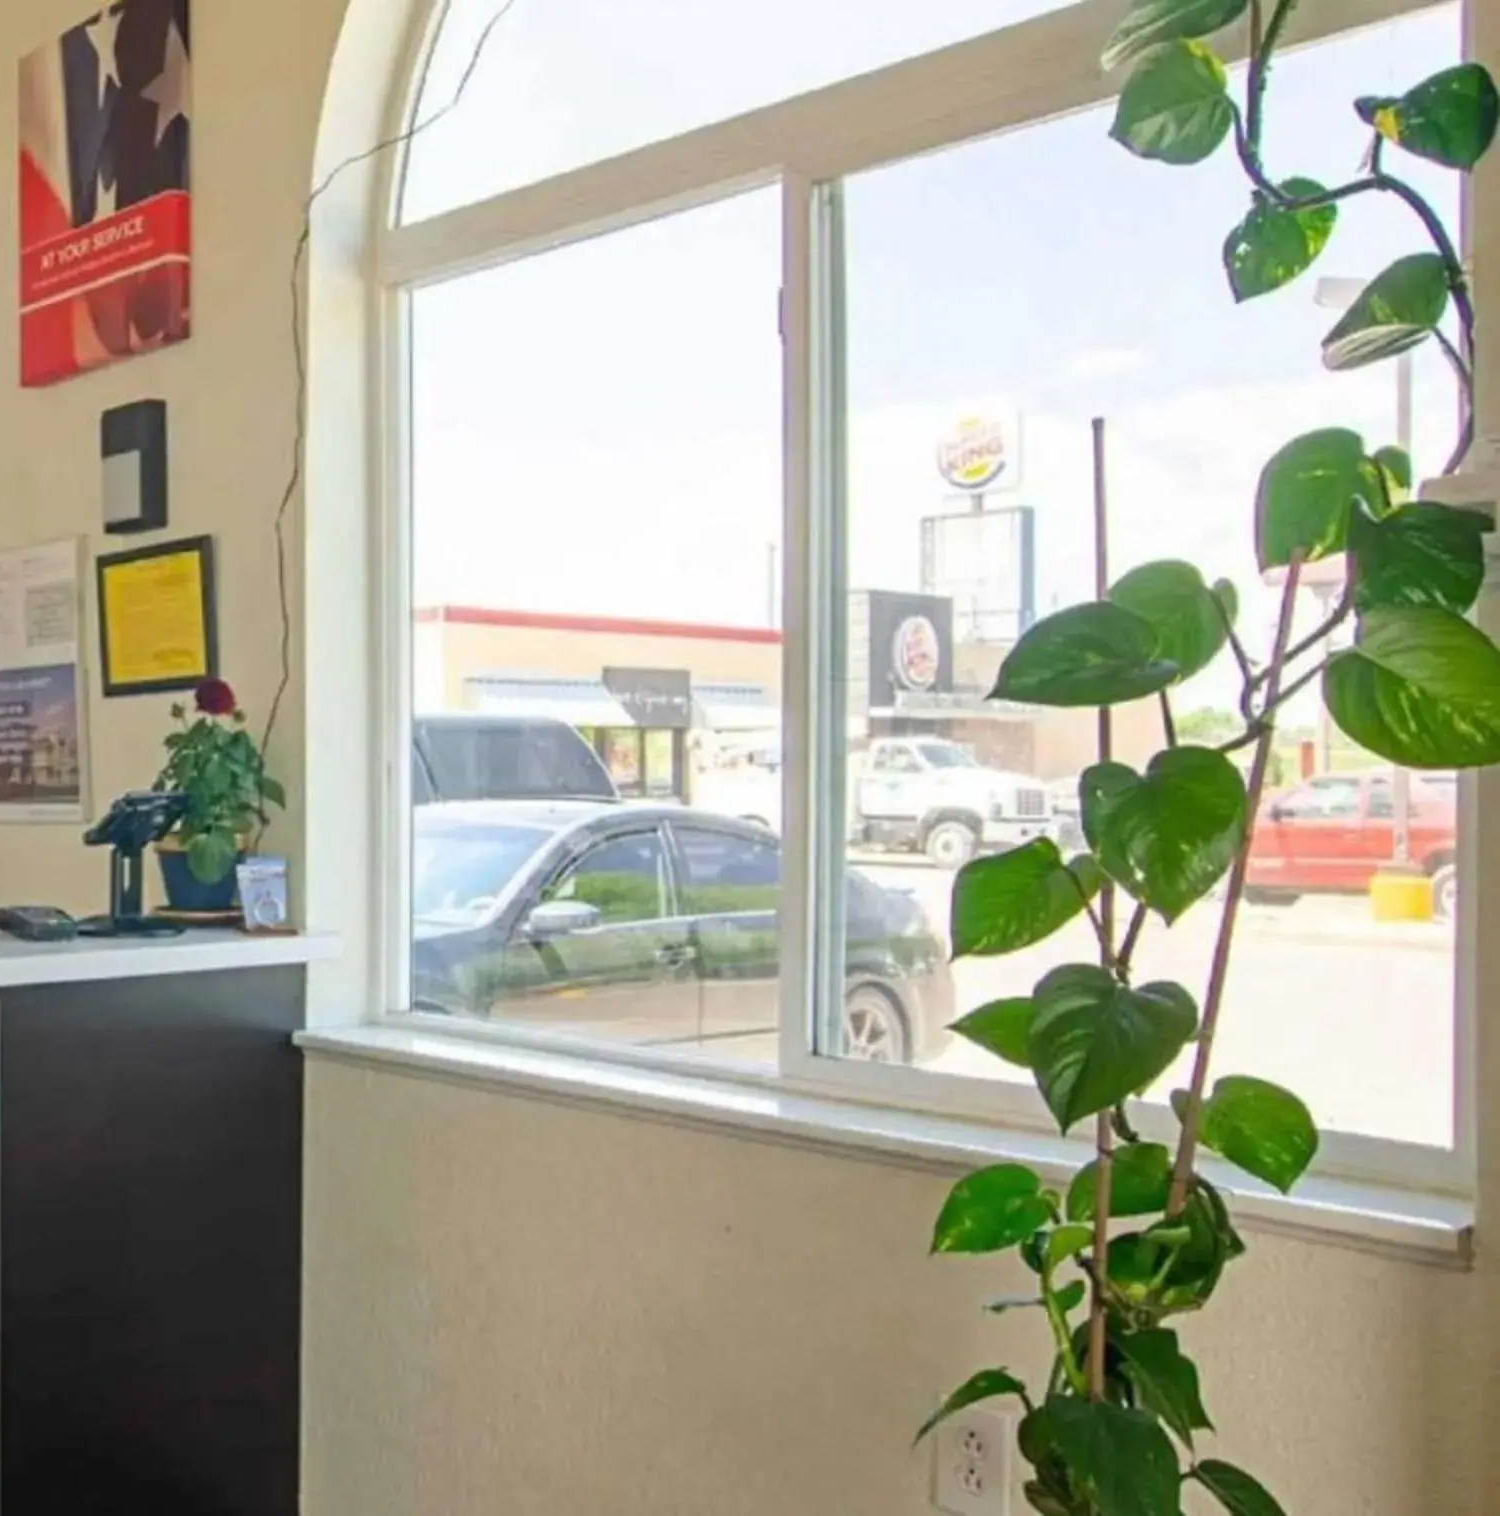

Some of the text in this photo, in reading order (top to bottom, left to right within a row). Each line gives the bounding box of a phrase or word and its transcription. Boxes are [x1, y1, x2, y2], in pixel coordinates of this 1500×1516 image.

[40, 251, 55, 271] AT
[58, 238, 91, 264] YOUR
[93, 216, 145, 250] SERVICE
